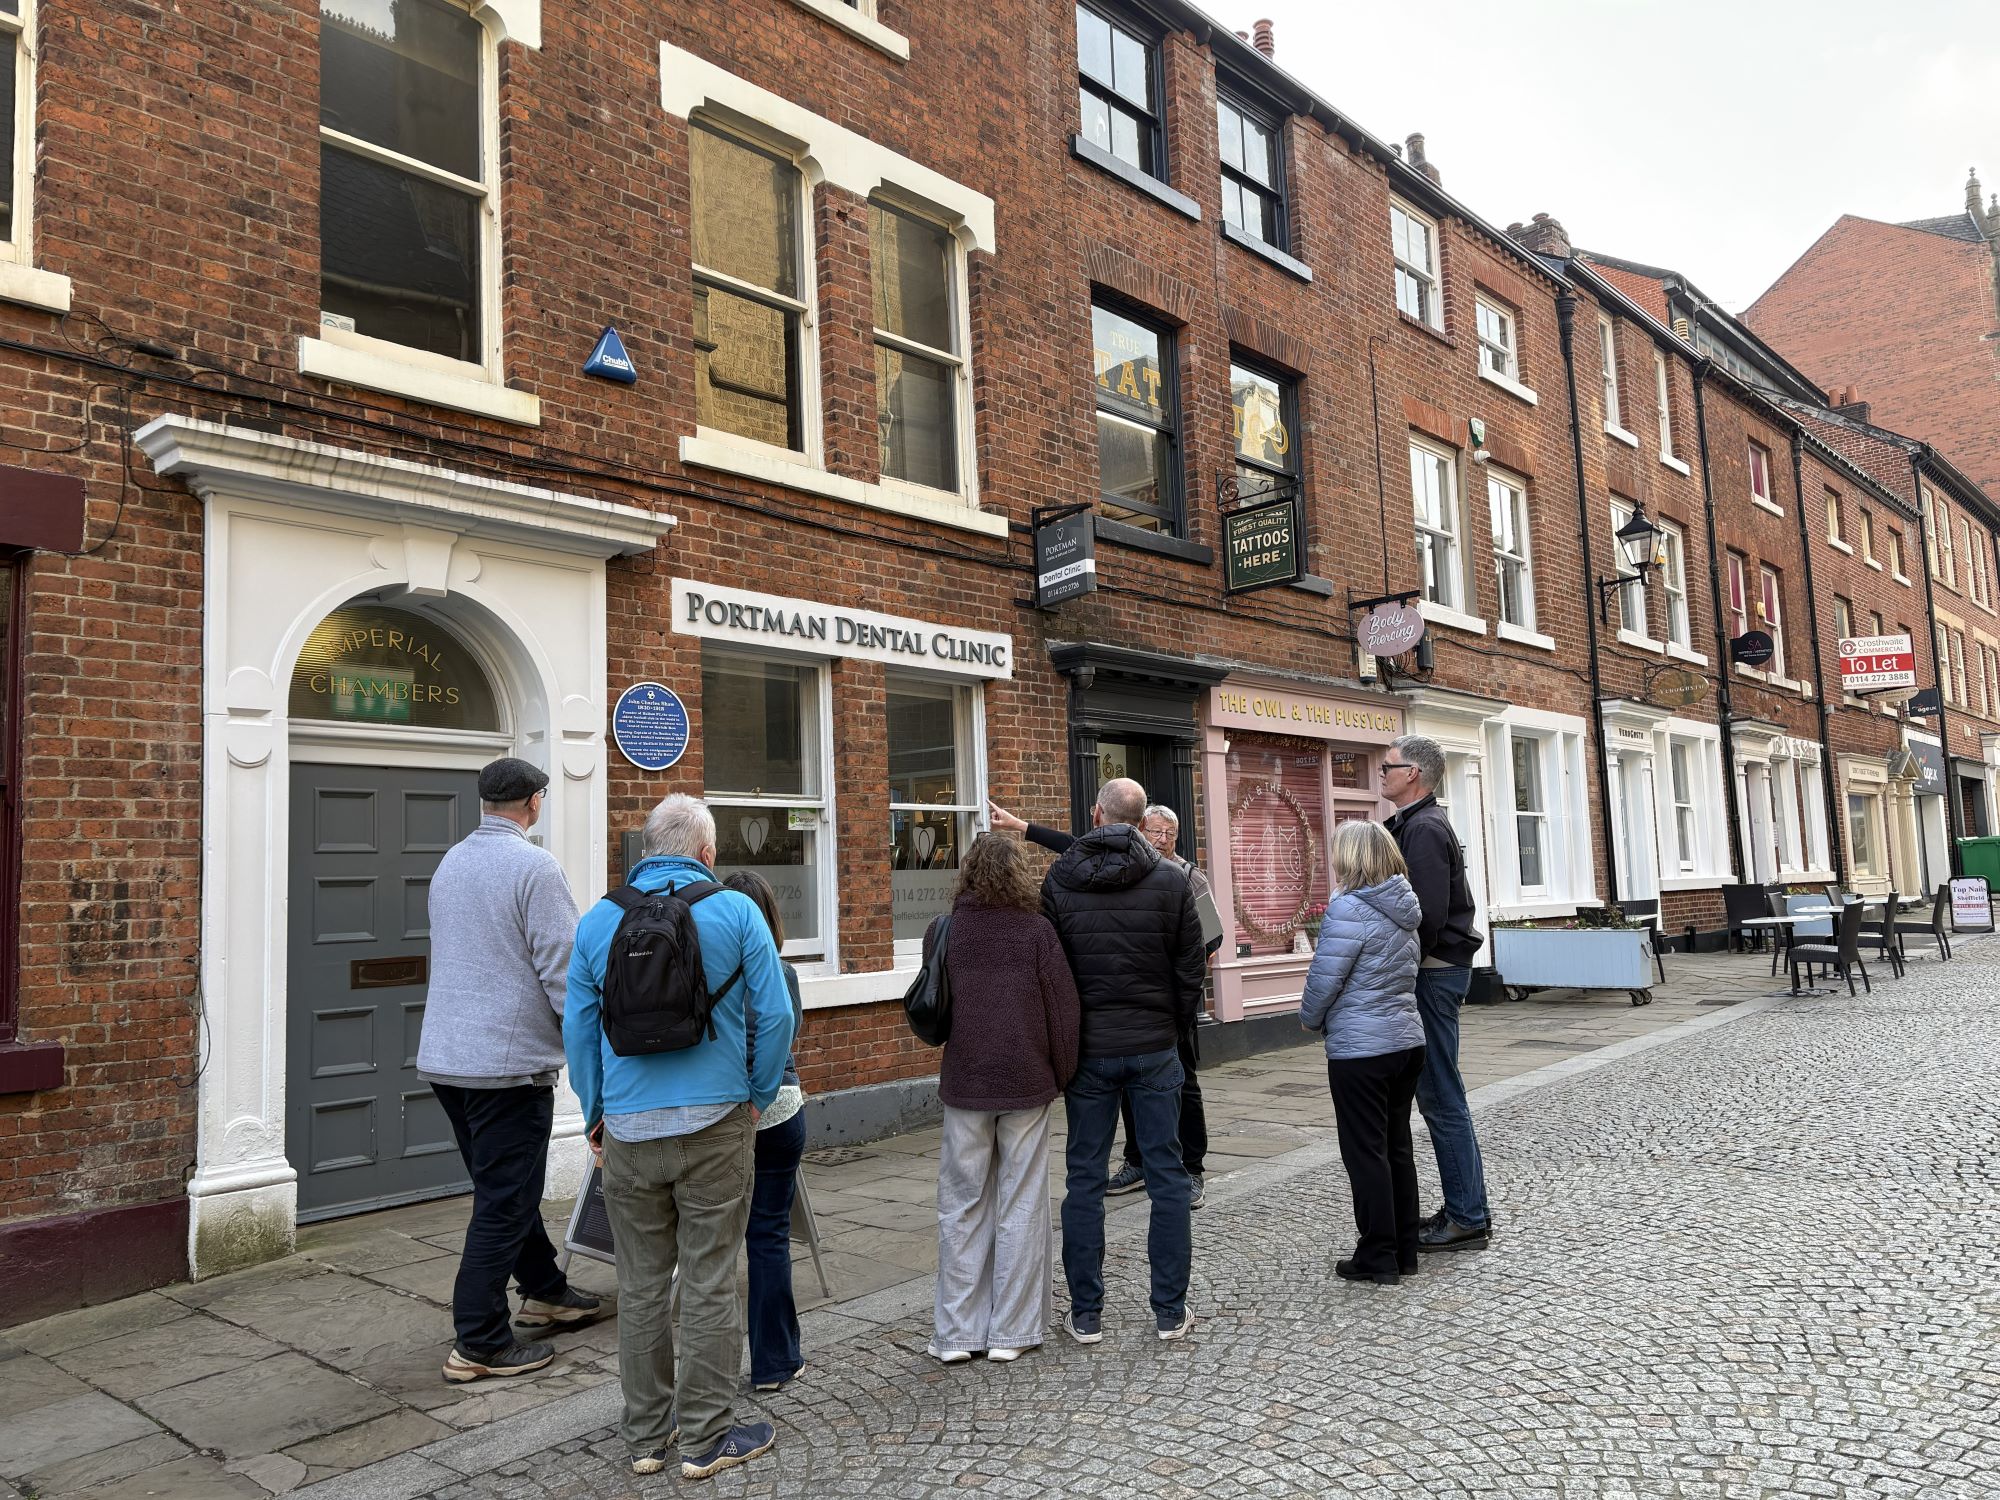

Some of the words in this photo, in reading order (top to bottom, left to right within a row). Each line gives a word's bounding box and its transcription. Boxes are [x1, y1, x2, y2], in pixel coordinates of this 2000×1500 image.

[1109, 330, 1141, 354] TRUE
[602, 354, 629, 367] Chubb
[1094, 348, 1161, 407] TAT
[1233, 521, 1257, 537] FINEST
[1258, 517, 1288, 527] QUALITY
[1045, 537, 1077, 556] PORTMAN
[1233, 528, 1290, 555] TATTOOS
[1243, 549, 1281, 569] HERE
[1043, 569, 1063, 584] Dental
[1064, 564, 1082, 577] Clinic
[1047, 588, 1058, 598] 0114
[1058, 585, 1068, 595] 272
[1068, 582, 1080, 592] 2726
[686, 592, 827, 641] PORTMAN
[834, 616, 928, 655] DENTAL
[931, 632, 1006, 667] CLINIC
[1368, 610, 1406, 635] Body
[1367, 624, 1416, 649] Piercing
[1857, 637, 1904, 648] Crosthwaite
[321, 628, 443, 672] IMPERIAL
[1858, 645, 1905, 654] COMMERCIAL
[1847, 657, 1867, 673] To
[1872, 655, 1899, 672] Let
[1843, 676, 1848, 684] T
[1849, 674, 1869, 683] 0114
[1871, 673, 1887, 681] 272
[1889, 672, 1910, 680] 3888
[310, 674, 460, 704] CHAMBERS
[1219, 691, 1249, 715] THE
[1253, 696, 1287, 721] OWL
[1291, 702, 1302, 722] &
[1306, 703, 1332, 726] THE
[1335, 707, 1398, 733] PUSSYCAT
[1255, 784, 1263, 797] &
[1264, 782, 1283, 795] THE
[917, 887, 936, 902] 272
[1952, 886, 1966, 894] Top
[1272, 899, 1310, 935] PIERCING
